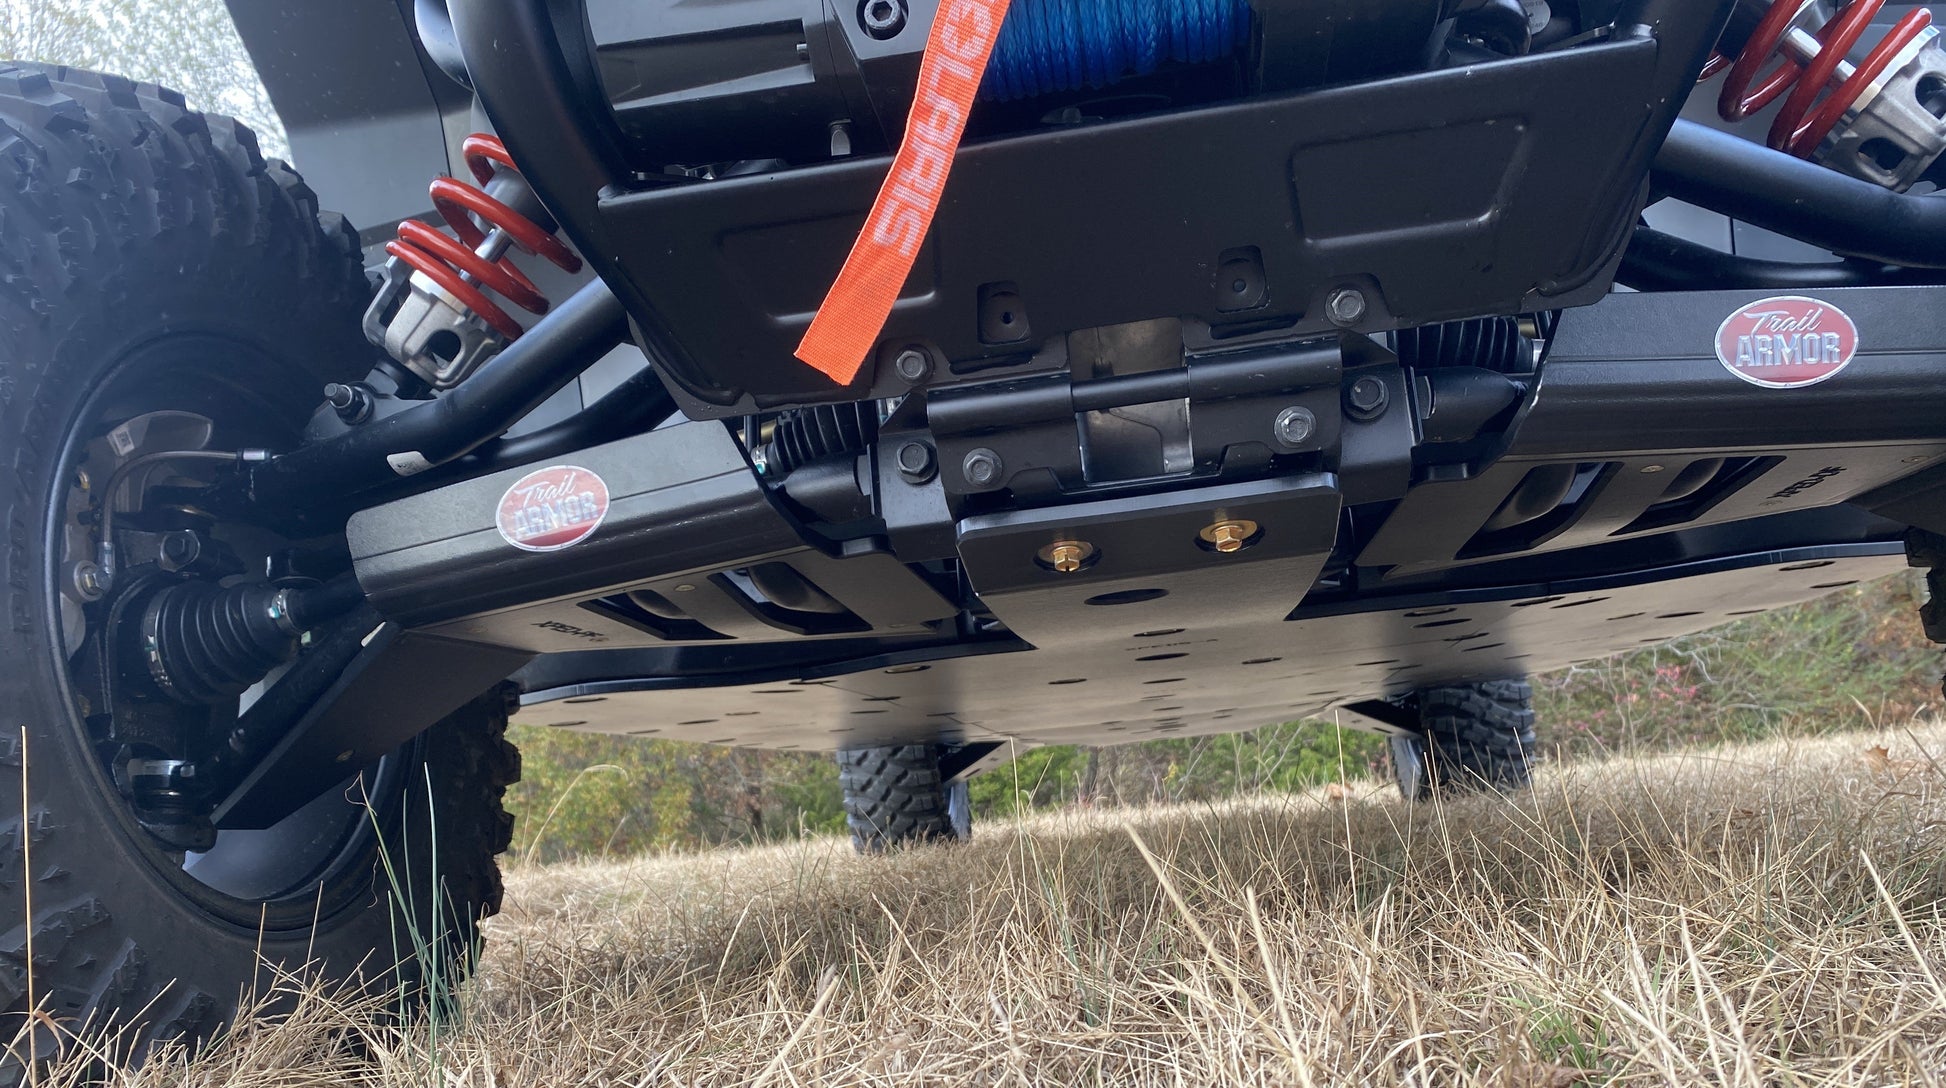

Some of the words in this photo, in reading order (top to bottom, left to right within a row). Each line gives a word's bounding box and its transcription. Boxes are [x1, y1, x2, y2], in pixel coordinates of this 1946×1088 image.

[873, 0, 996, 257] OLARIS
[1743, 307, 1824, 338] Trail
[1735, 331, 1842, 367] ARMOR
[514, 471, 577, 508] Trail
[513, 490, 599, 539] ARMOR
